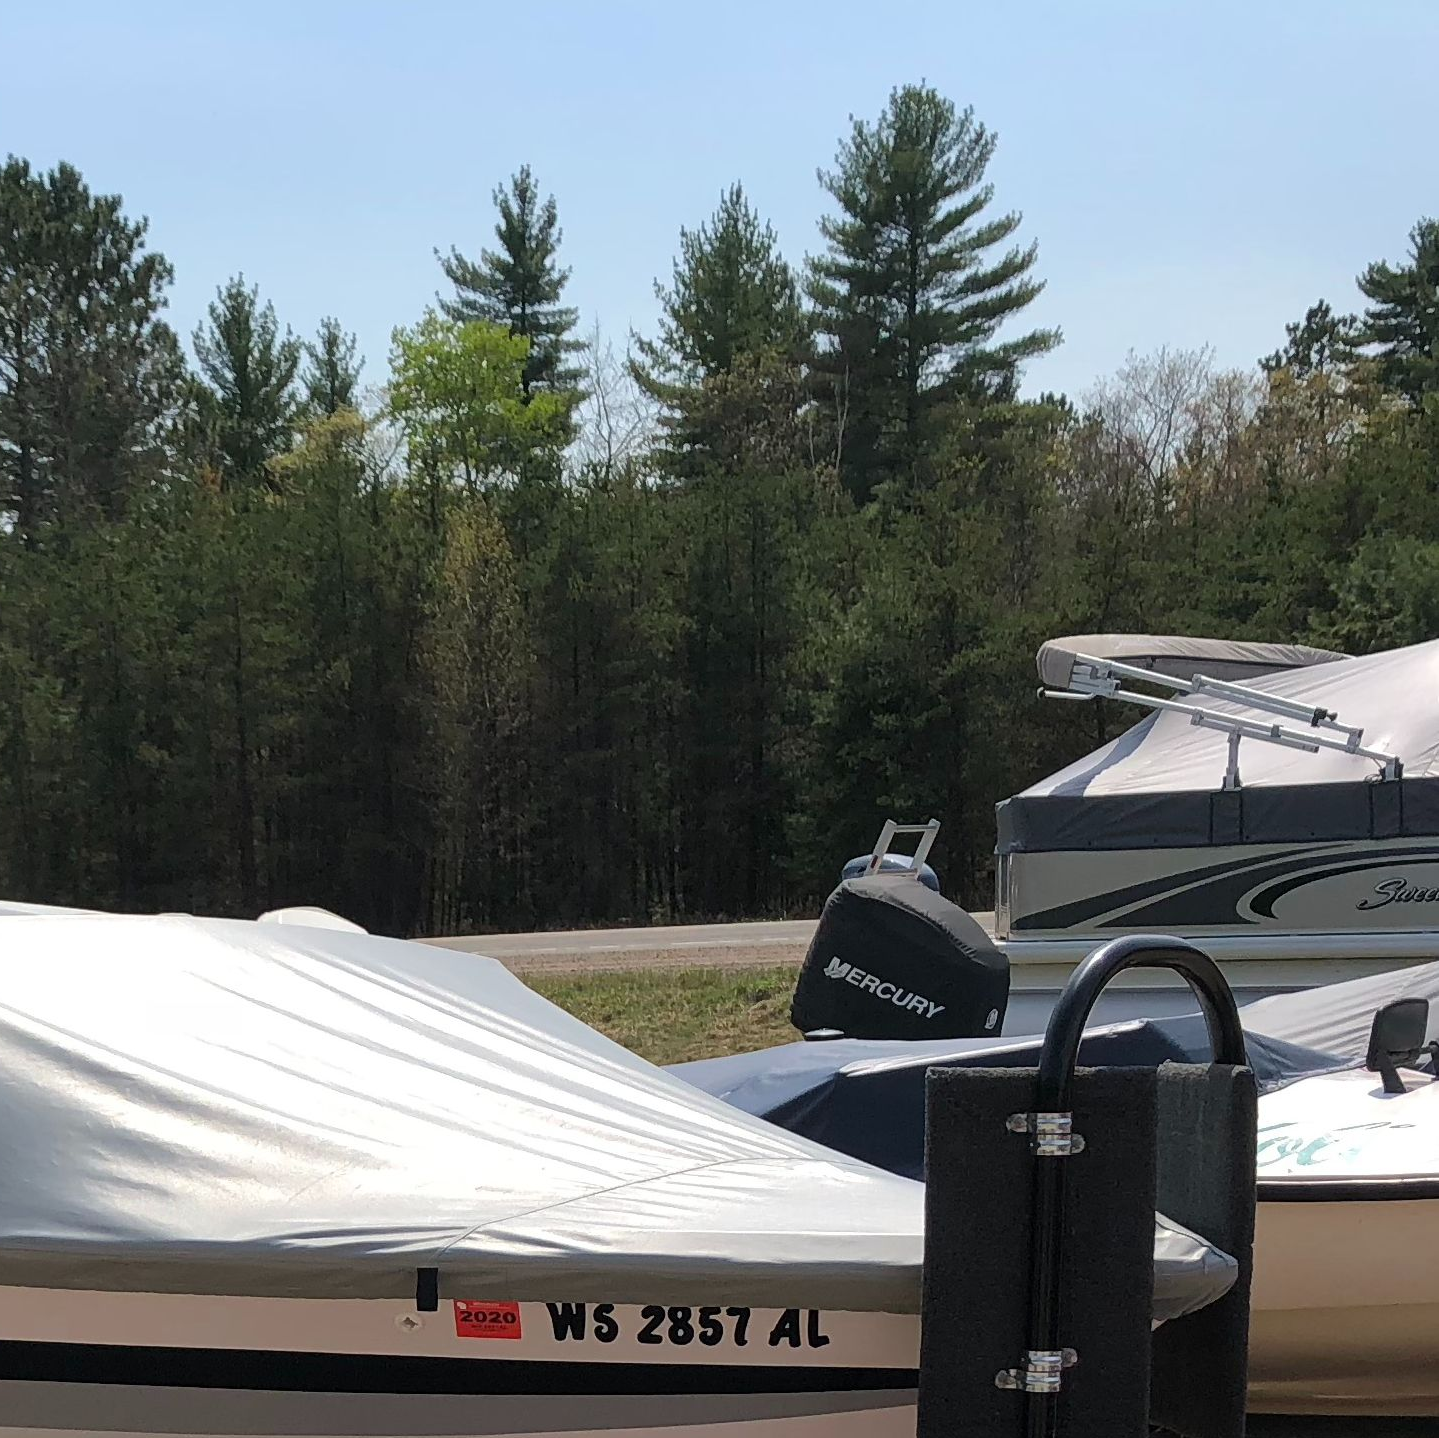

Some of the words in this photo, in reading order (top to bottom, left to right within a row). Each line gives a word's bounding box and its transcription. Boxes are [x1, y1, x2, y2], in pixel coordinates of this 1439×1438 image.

[823, 955, 946, 1020] MERCURY
[458, 1310, 517, 1324] 2020
[545, 1302, 619, 1343] WS
[636, 1304, 751, 1346] 2857
[768, 1308, 831, 1348] AL
